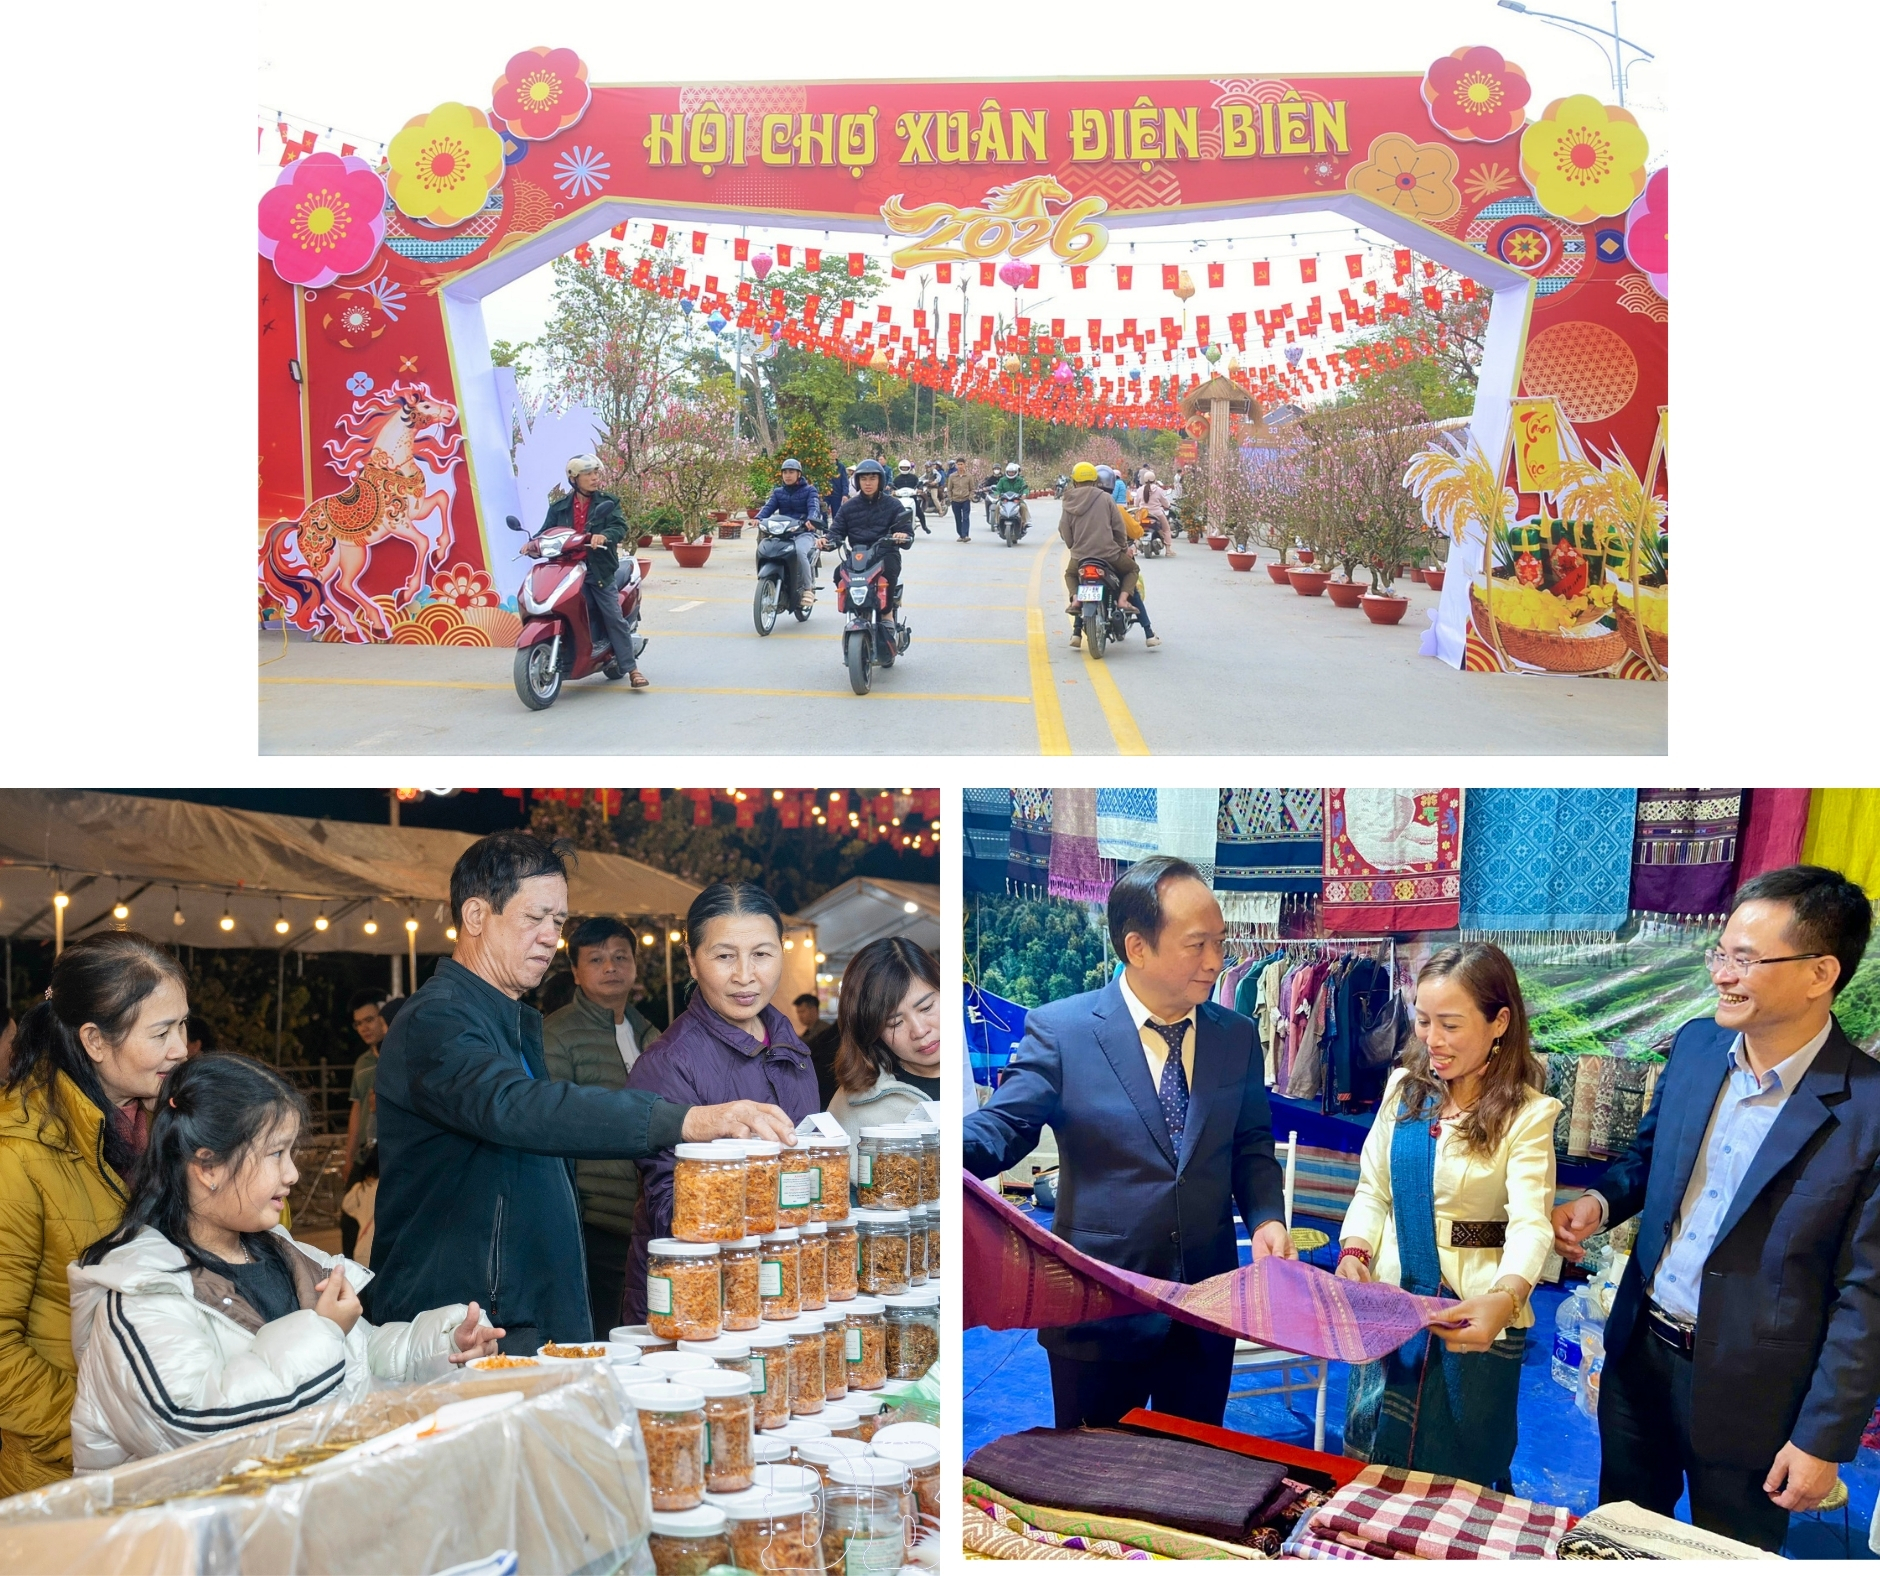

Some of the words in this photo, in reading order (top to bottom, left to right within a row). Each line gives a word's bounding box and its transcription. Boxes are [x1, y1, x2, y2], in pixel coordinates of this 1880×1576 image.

[643, 100, 748, 178] HỘI
[761, 105, 879, 179] CHỢ
[895, 97, 1049, 163] XUÂN
[1068, 95, 1200, 173] ĐIỆN
[1218, 89, 1350, 160] BIÊN
[880, 190, 1109, 268] 2026
